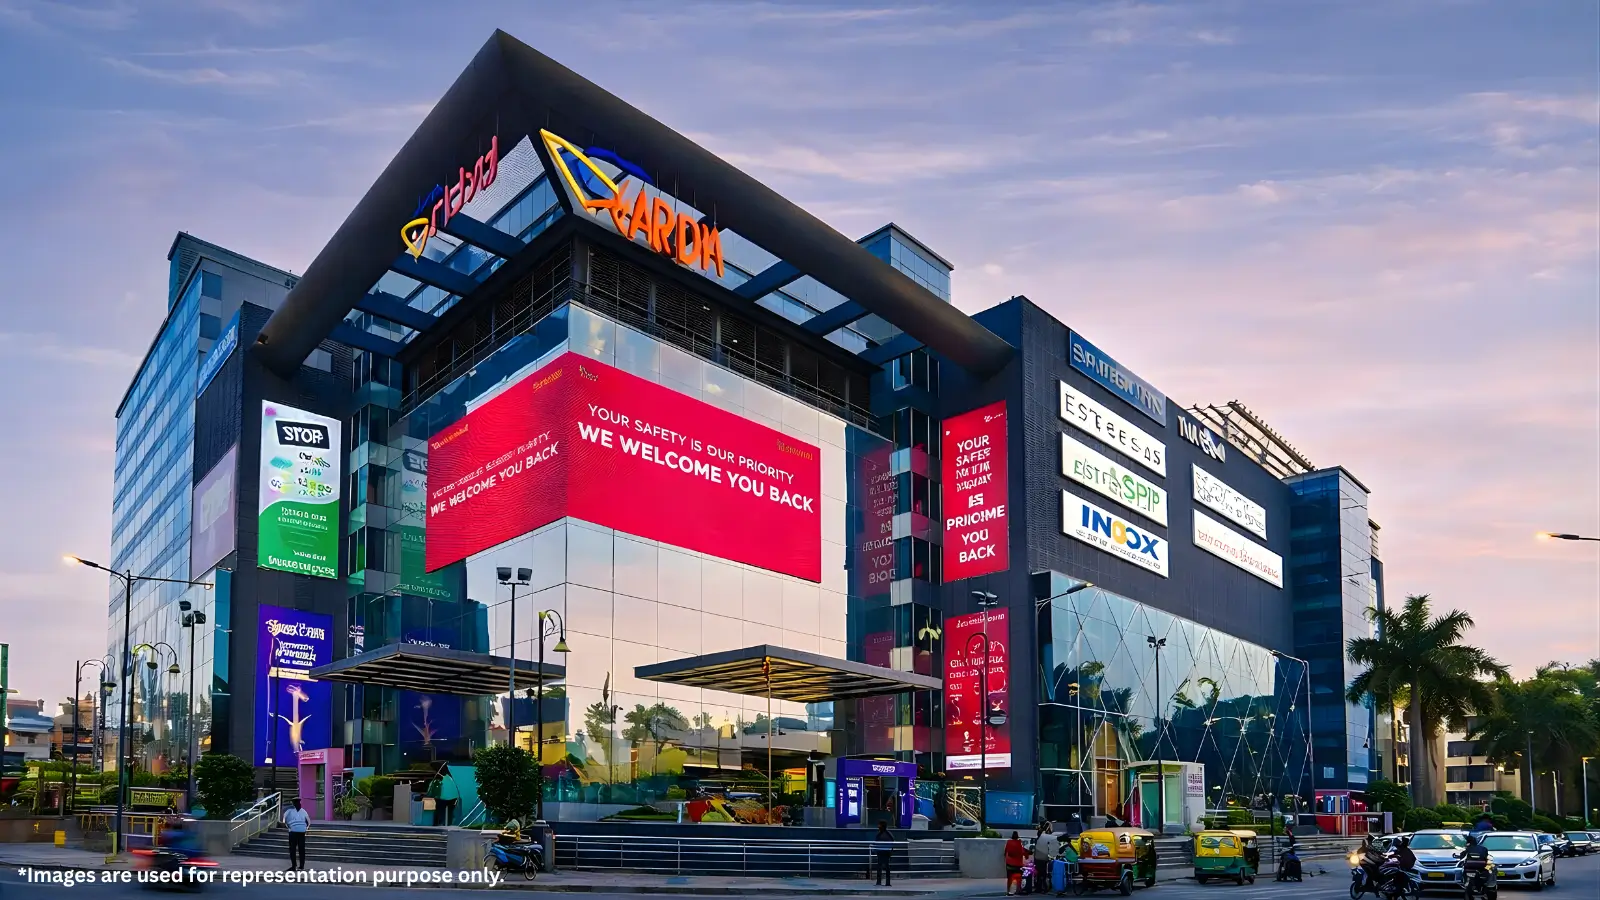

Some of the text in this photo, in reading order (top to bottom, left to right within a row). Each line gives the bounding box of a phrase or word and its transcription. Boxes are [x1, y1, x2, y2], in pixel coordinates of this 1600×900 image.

[578, 421, 814, 513] WE WELCOME YOU BACK
[588, 403, 794, 485] YOUR SAFETY IS OUR PRIORITY
[957, 435, 990, 453] YOUR
[430, 441, 559, 518] WE WELCOME YOU BACK
[959, 544, 996, 563] BACK
[961, 528, 989, 546] YOU
